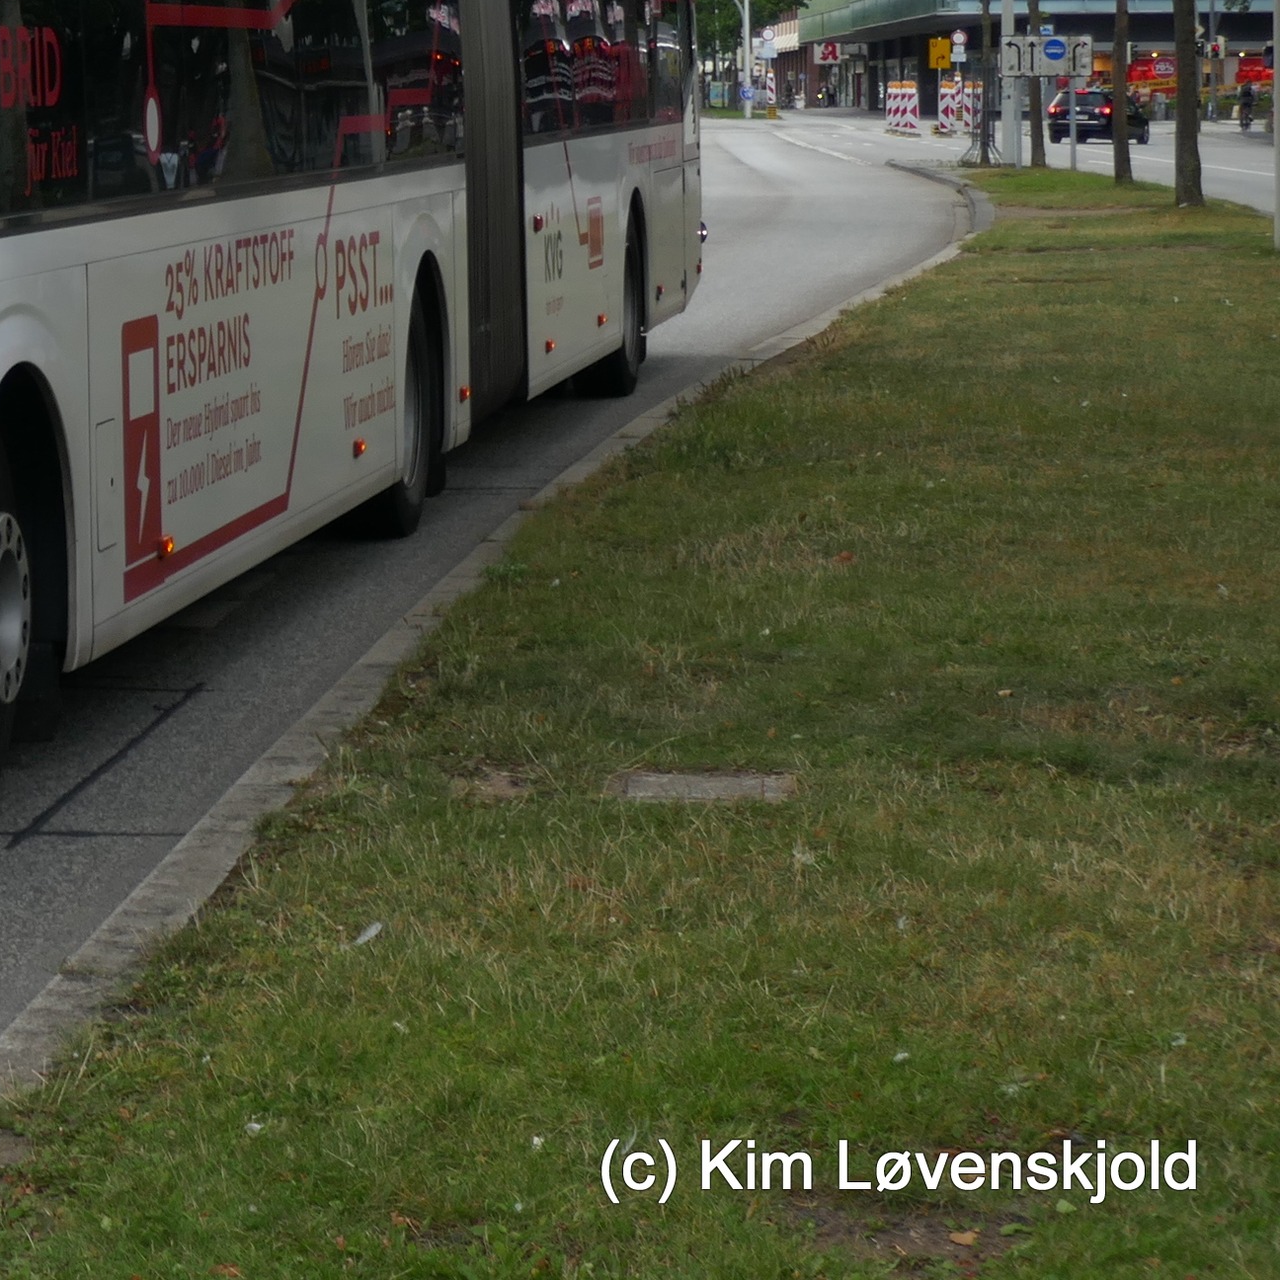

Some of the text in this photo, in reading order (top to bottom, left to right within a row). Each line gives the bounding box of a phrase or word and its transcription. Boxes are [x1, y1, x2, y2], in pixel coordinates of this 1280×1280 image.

[165, 228, 295, 320] 25% KRAFTSTOFF
[335, 230, 393, 319] PSST...
[544, 229, 563, 284] KVG
[166, 312, 251, 395] ERSPARNIS
[167, 417, 181, 450] Der
[204, 392, 229, 441] Hybrid
